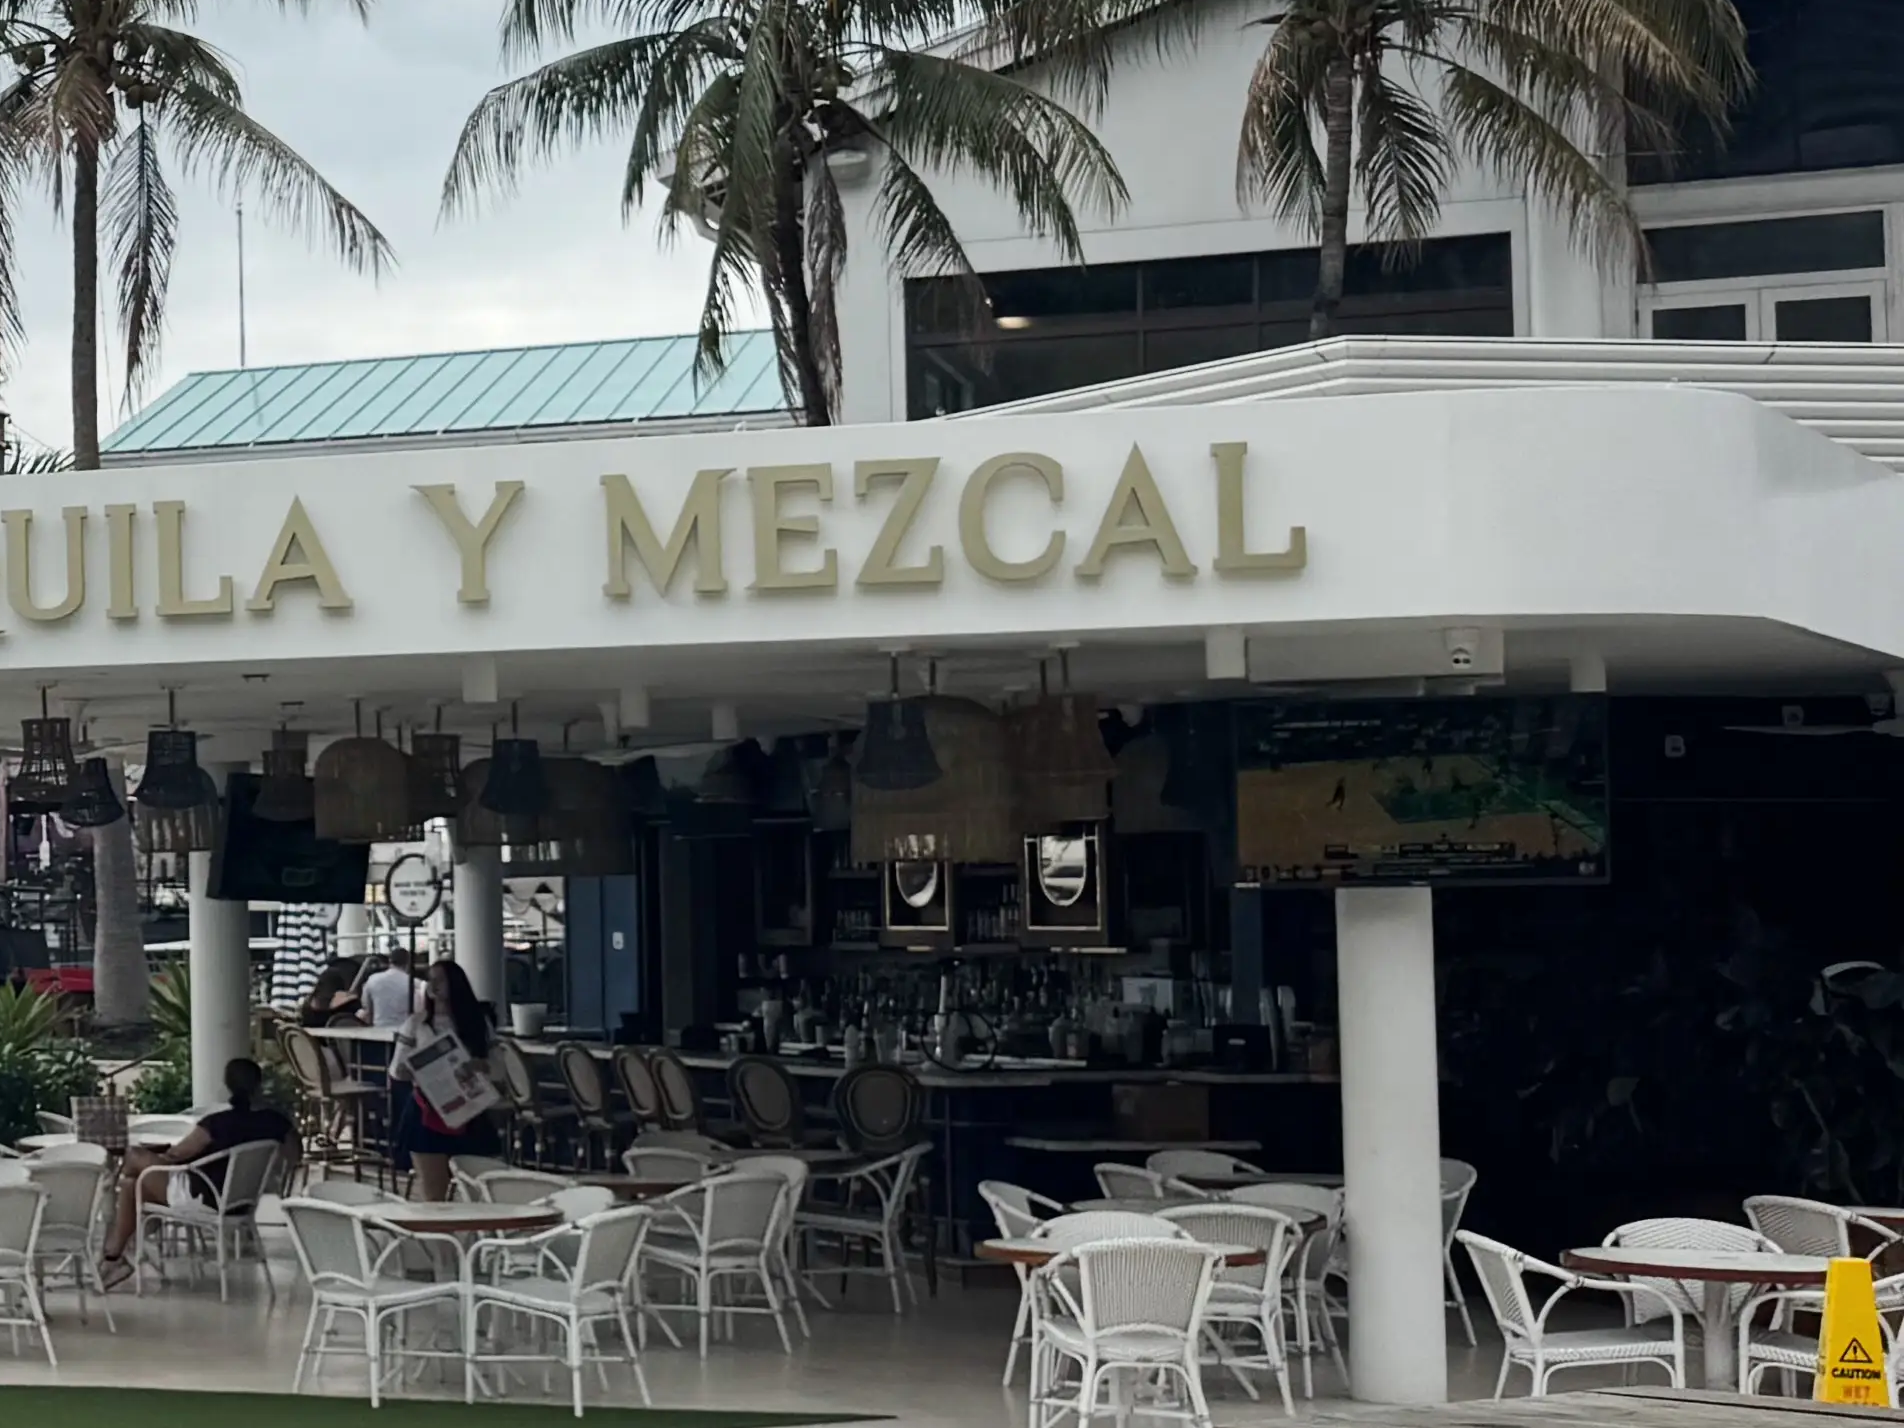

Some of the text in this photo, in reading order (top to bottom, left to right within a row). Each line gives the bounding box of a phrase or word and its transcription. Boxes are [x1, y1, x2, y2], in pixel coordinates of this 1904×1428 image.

[409, 480, 525, 603] Y
[600, 441, 1307, 599] MEZCAL
[1831, 1367, 1881, 1380] CAUTION
